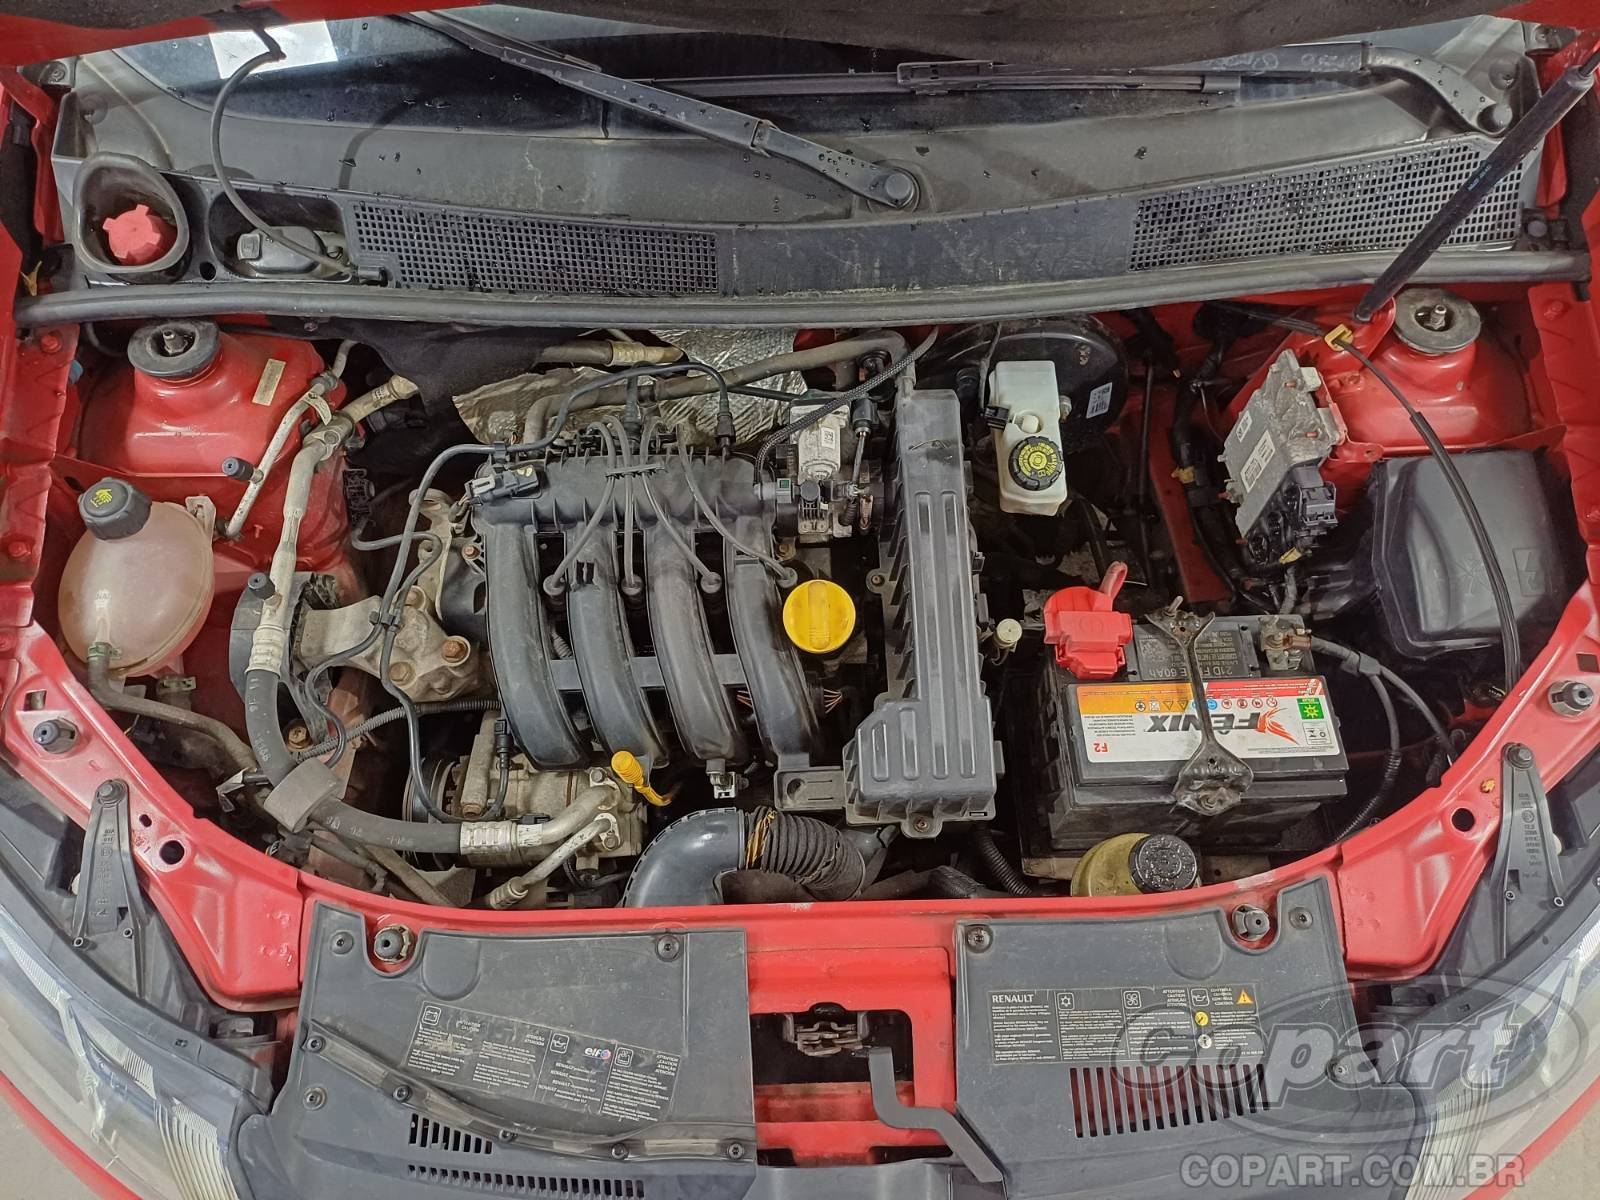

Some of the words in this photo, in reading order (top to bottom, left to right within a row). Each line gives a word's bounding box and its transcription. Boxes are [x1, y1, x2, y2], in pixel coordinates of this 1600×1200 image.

[1093, 742, 1109, 753] F2
[991, 993, 1035, 1004] RENAULT
[584, 1046, 602, 1057] elf
